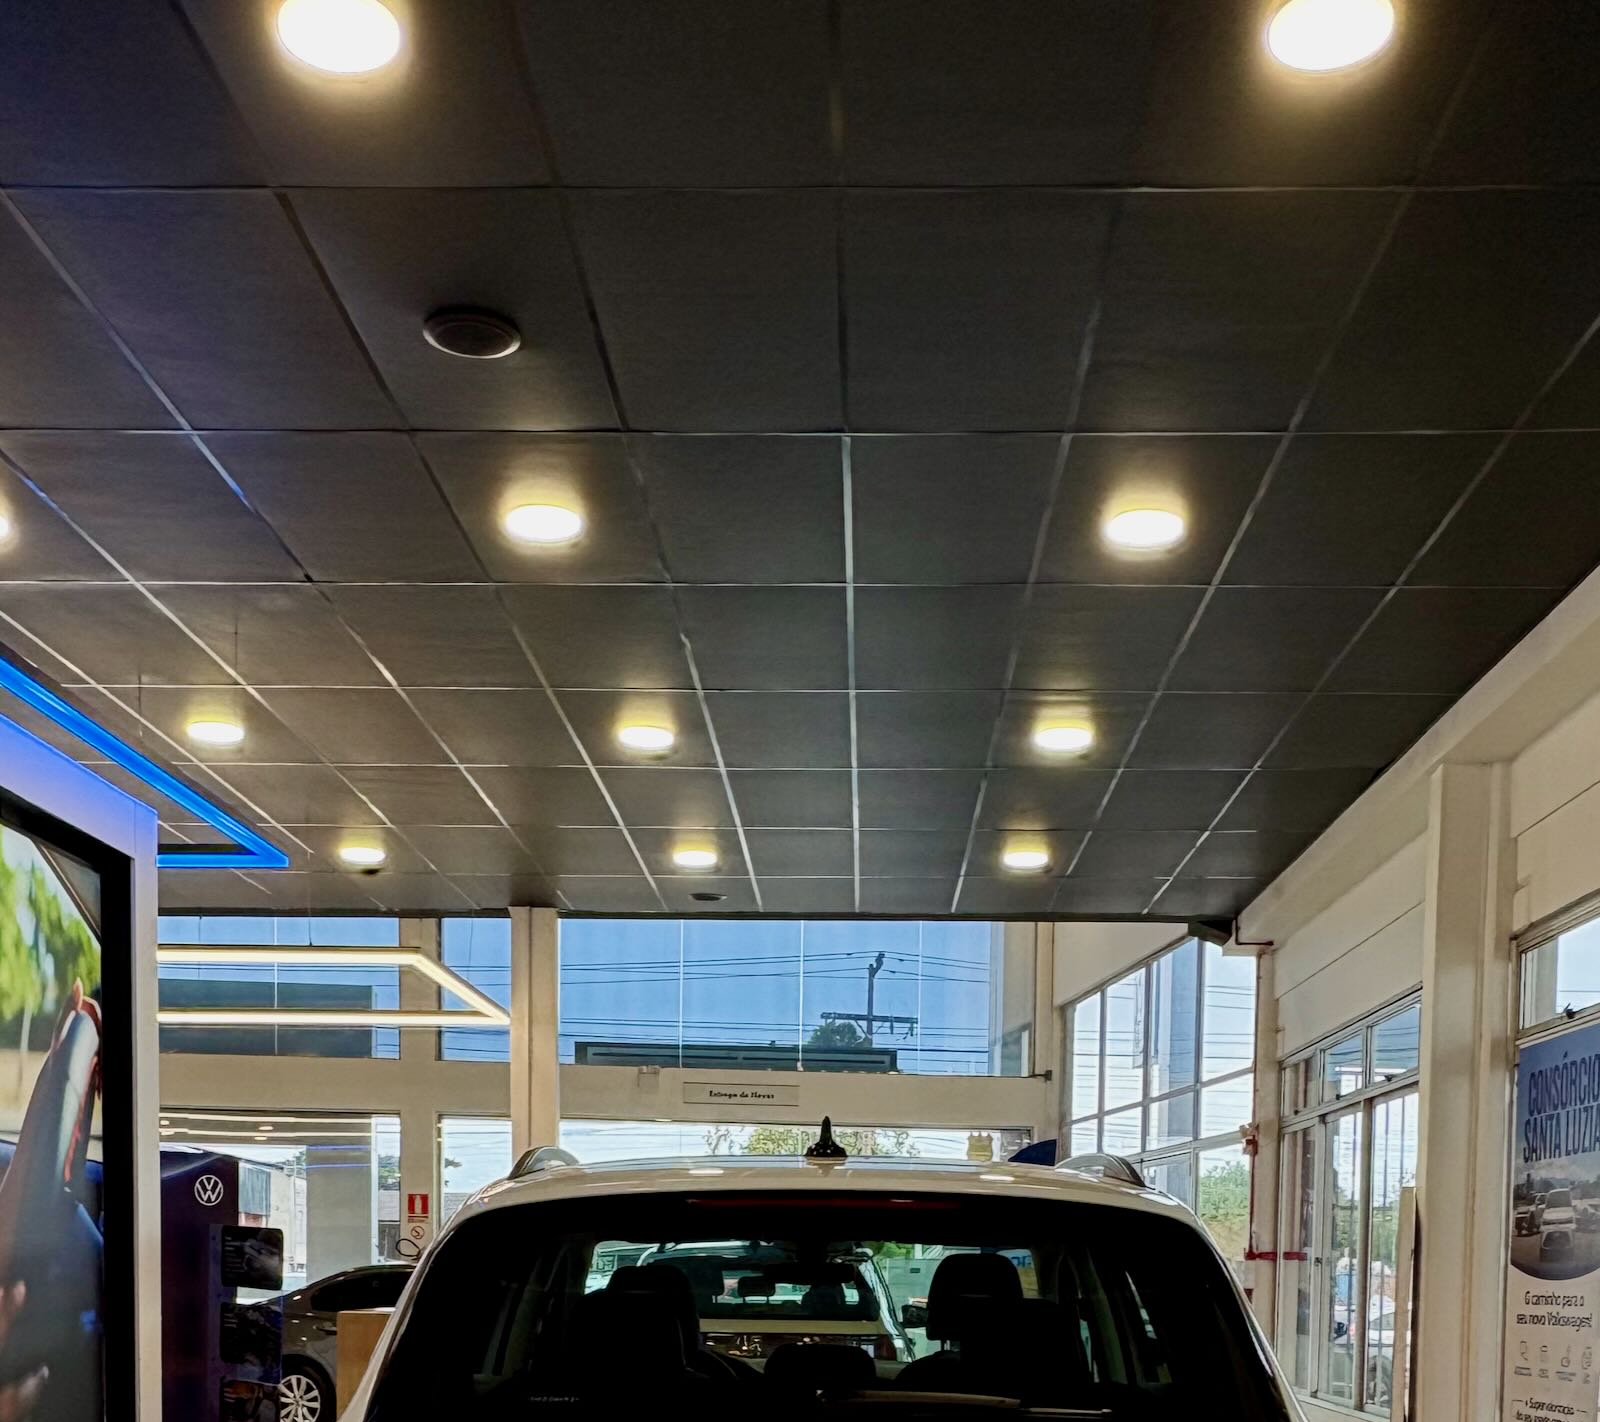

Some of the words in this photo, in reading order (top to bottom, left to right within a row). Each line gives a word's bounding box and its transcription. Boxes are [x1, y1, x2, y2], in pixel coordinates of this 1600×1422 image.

[1528, 1051, 1600, 1117] CONSÓRCIO
[1523, 1112, 1562, 1163] SANTA
[1565, 1103, 1600, 1157] LUZIA
